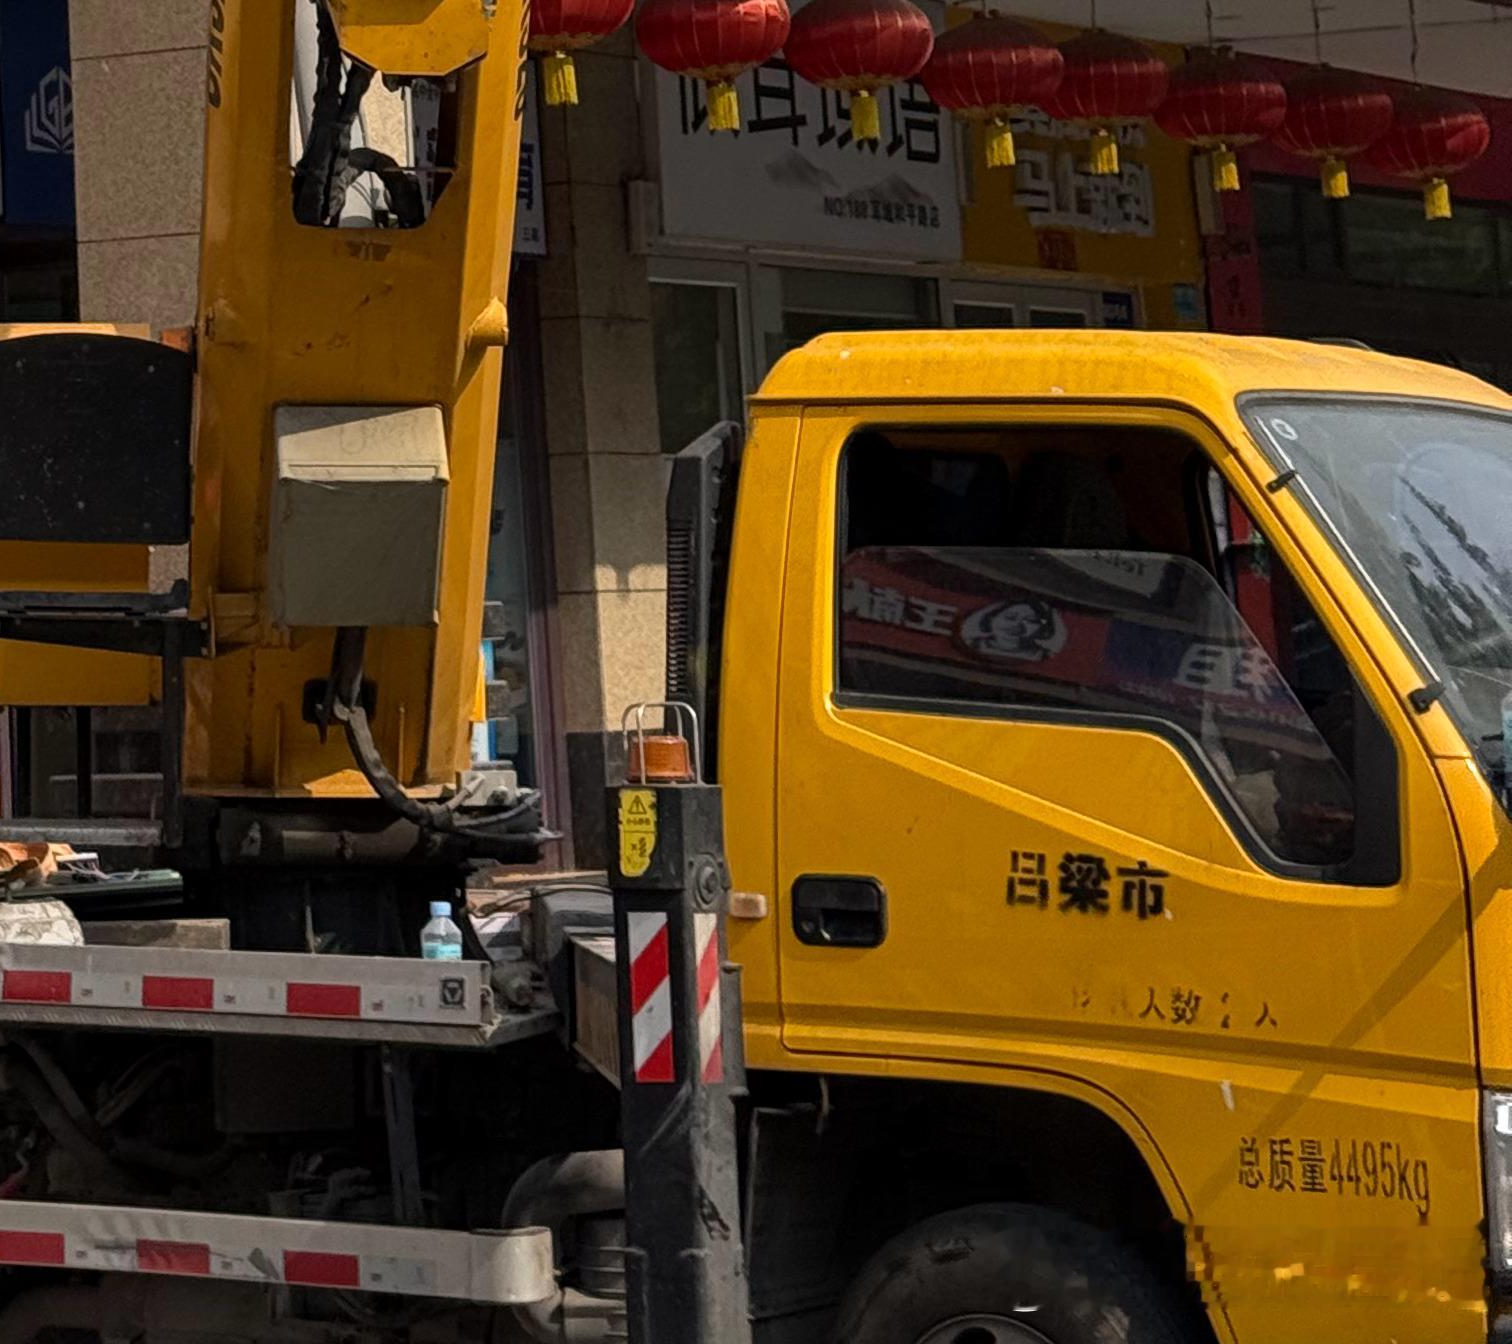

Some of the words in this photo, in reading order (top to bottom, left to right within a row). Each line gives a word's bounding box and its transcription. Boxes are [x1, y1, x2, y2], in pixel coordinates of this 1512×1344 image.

[1006, 849, 1170, 921] 吕梁市
[1238, 1136, 1431, 1215] 总质量4495kg
